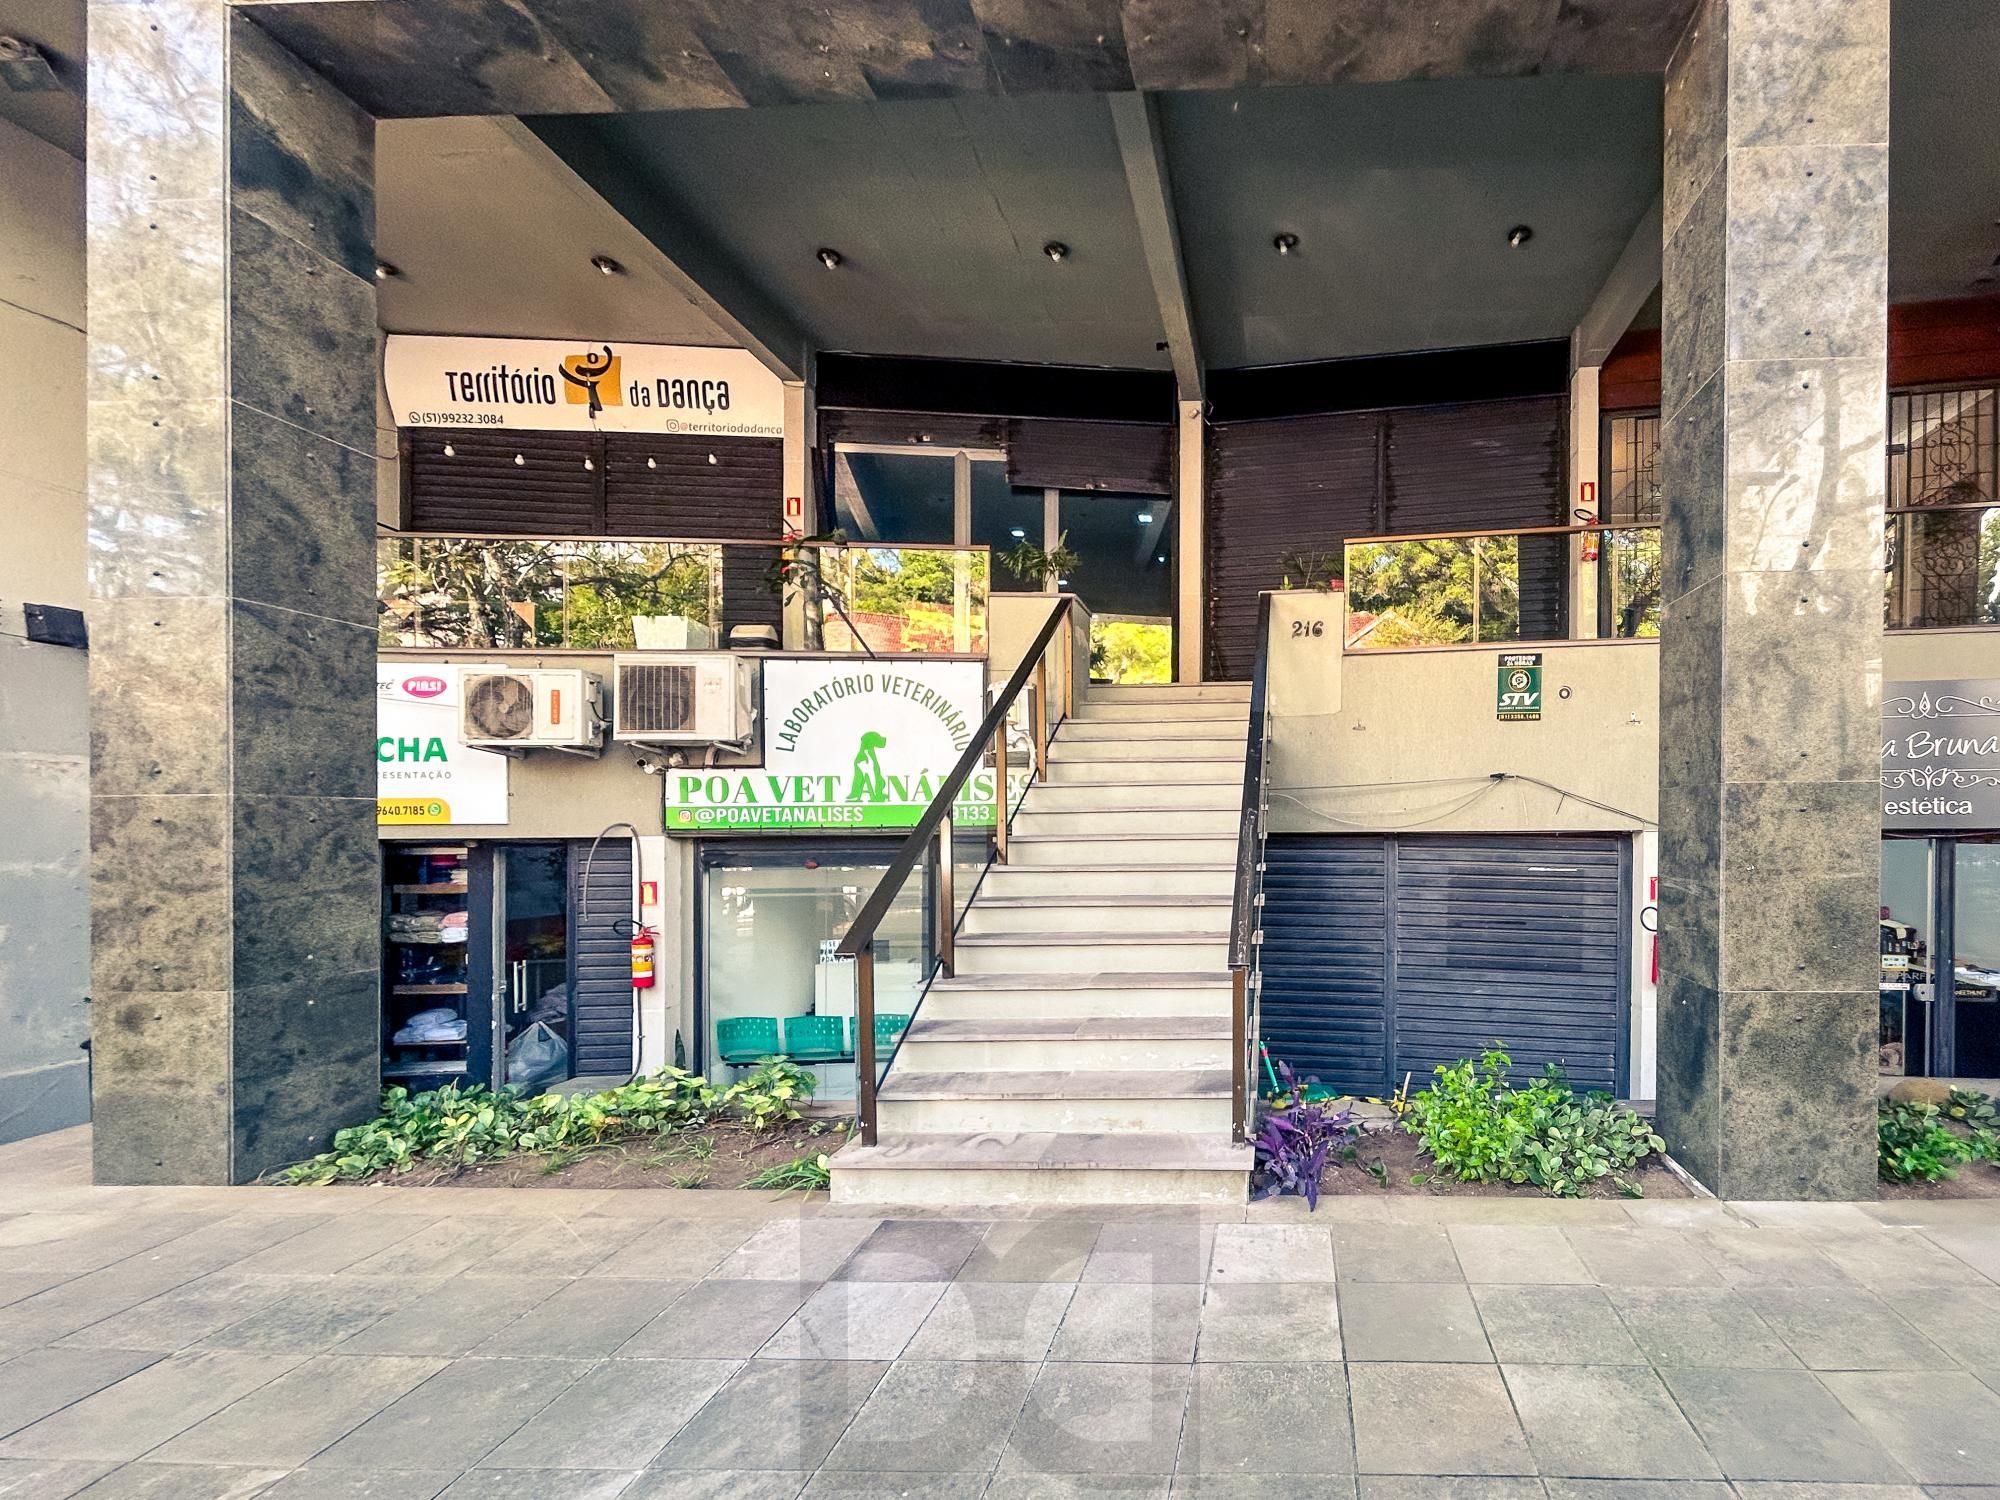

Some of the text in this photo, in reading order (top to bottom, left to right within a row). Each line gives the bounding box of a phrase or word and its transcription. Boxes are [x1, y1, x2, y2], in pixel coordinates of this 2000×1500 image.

[444, 364, 556, 404] Território
[629, 380, 651, 407] da
[1291, 620, 1324, 639] 216
[1498, 692, 1540, 706] STV
[776, 674, 874, 752] LABORATÓRIO
[376, 737, 448, 762] CHA
[1905, 730, 1999, 759] Bruna
[377, 770, 452, 780] ESENTAÇÃO
[678, 776, 758, 803] POA
[766, 776, 841, 803] VET
[695, 807, 864, 823] @POAVETANALISES
[1884, 797, 1972, 815] estética
